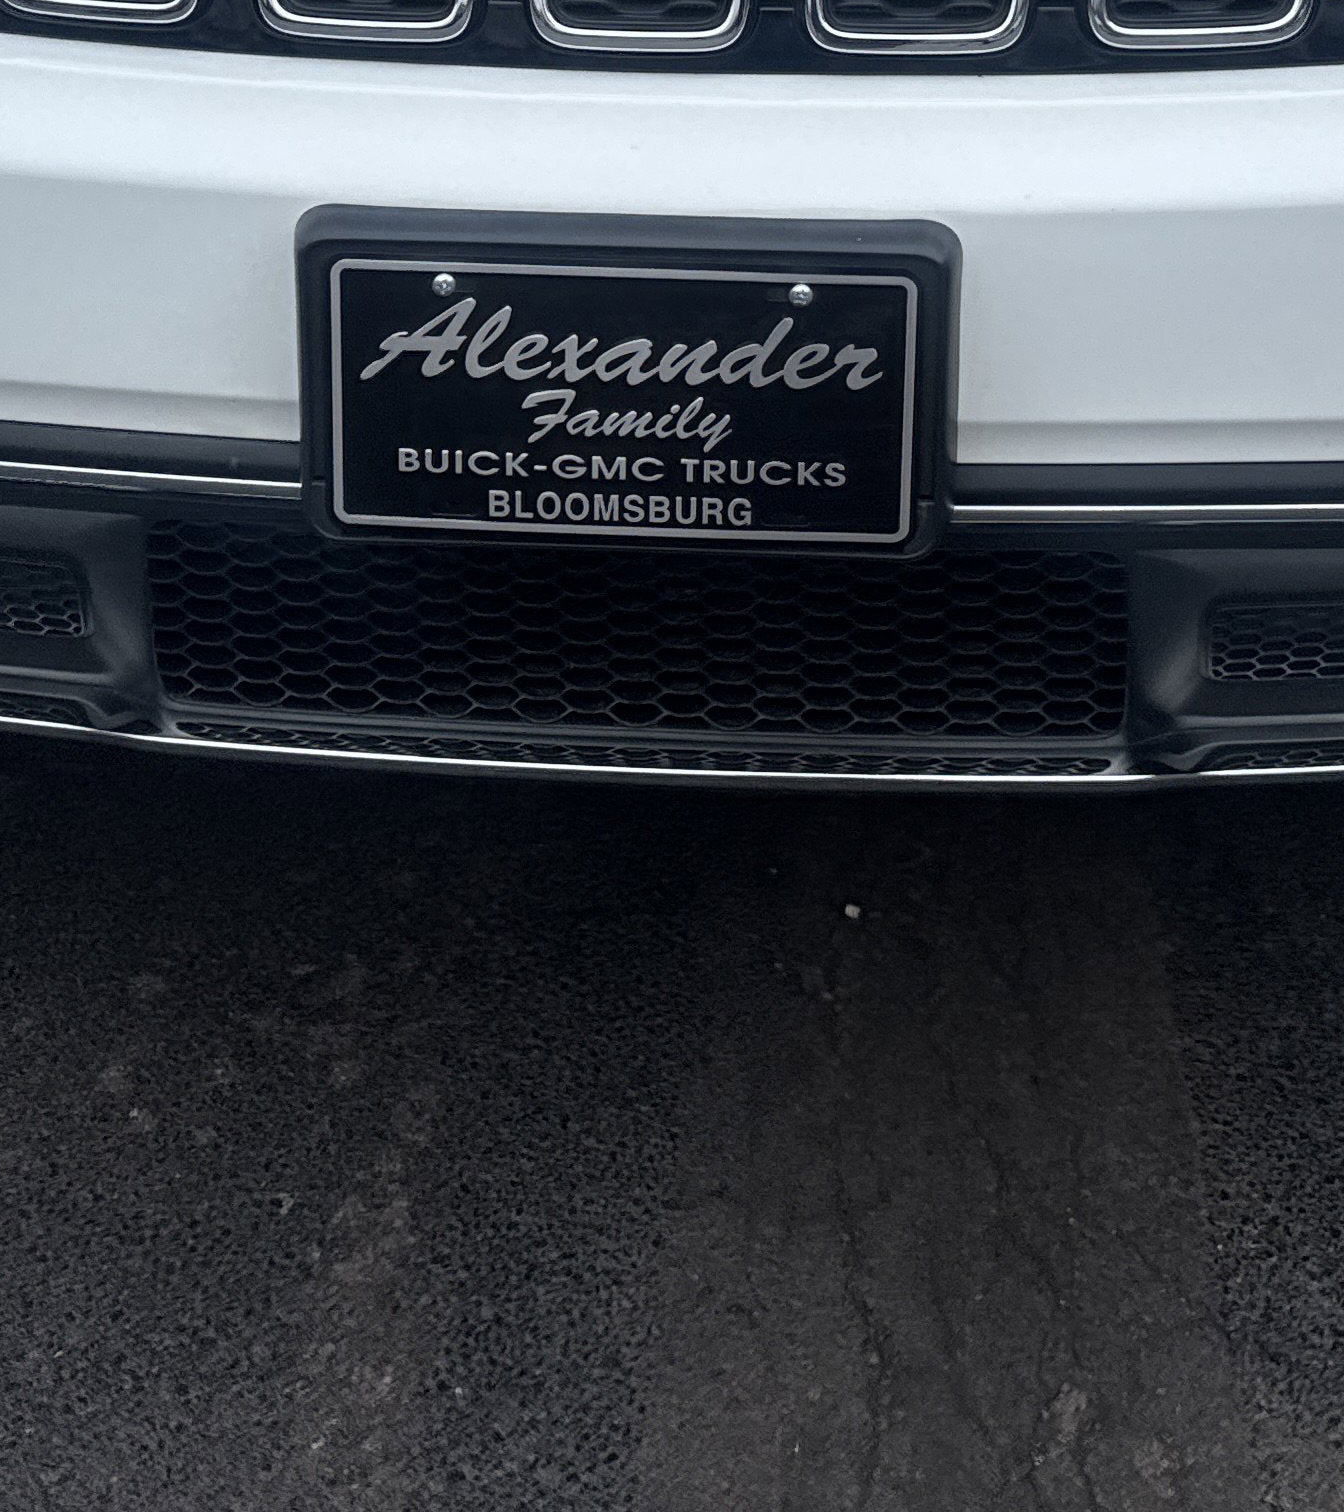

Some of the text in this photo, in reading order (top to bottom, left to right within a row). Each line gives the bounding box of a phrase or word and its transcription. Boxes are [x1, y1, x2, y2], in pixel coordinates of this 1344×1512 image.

[359, 296, 884, 391] Alexander
[520, 388, 732, 452] Family
[397, 447, 848, 488] BUICK-GMC TRUCKS
[487, 490, 754, 527] BLOOMSBURG
